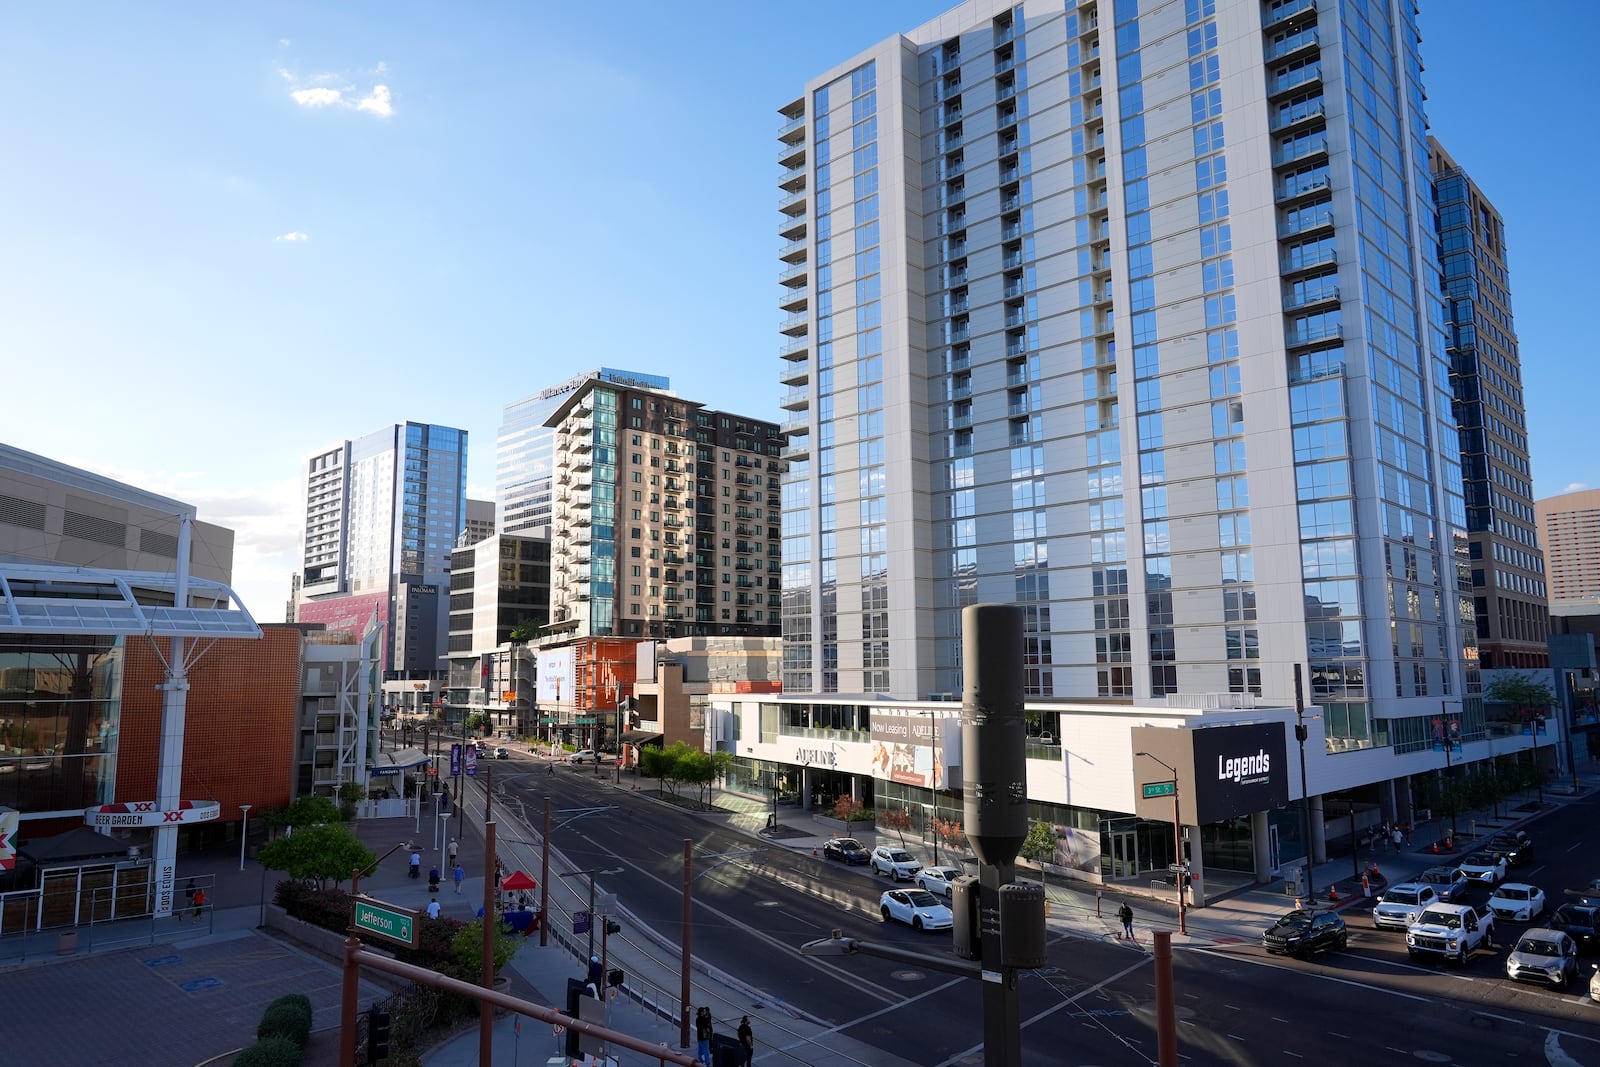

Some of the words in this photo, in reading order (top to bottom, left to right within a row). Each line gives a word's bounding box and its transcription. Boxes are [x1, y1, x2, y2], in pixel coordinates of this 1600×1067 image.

[872, 721, 885, 733] Now
[885, 722, 908, 737] Leasing
[796, 747, 838, 766] ADELINE
[1219, 749, 1270, 782] Legends
[134, 802, 153, 812] XX
[95, 815, 110, 826] BEER
[111, 815, 143, 826] GARDEN
[163, 811, 185, 823] XX
[162, 865, 172, 889] EQUIS
[361, 910, 393, 930] Jefferson
